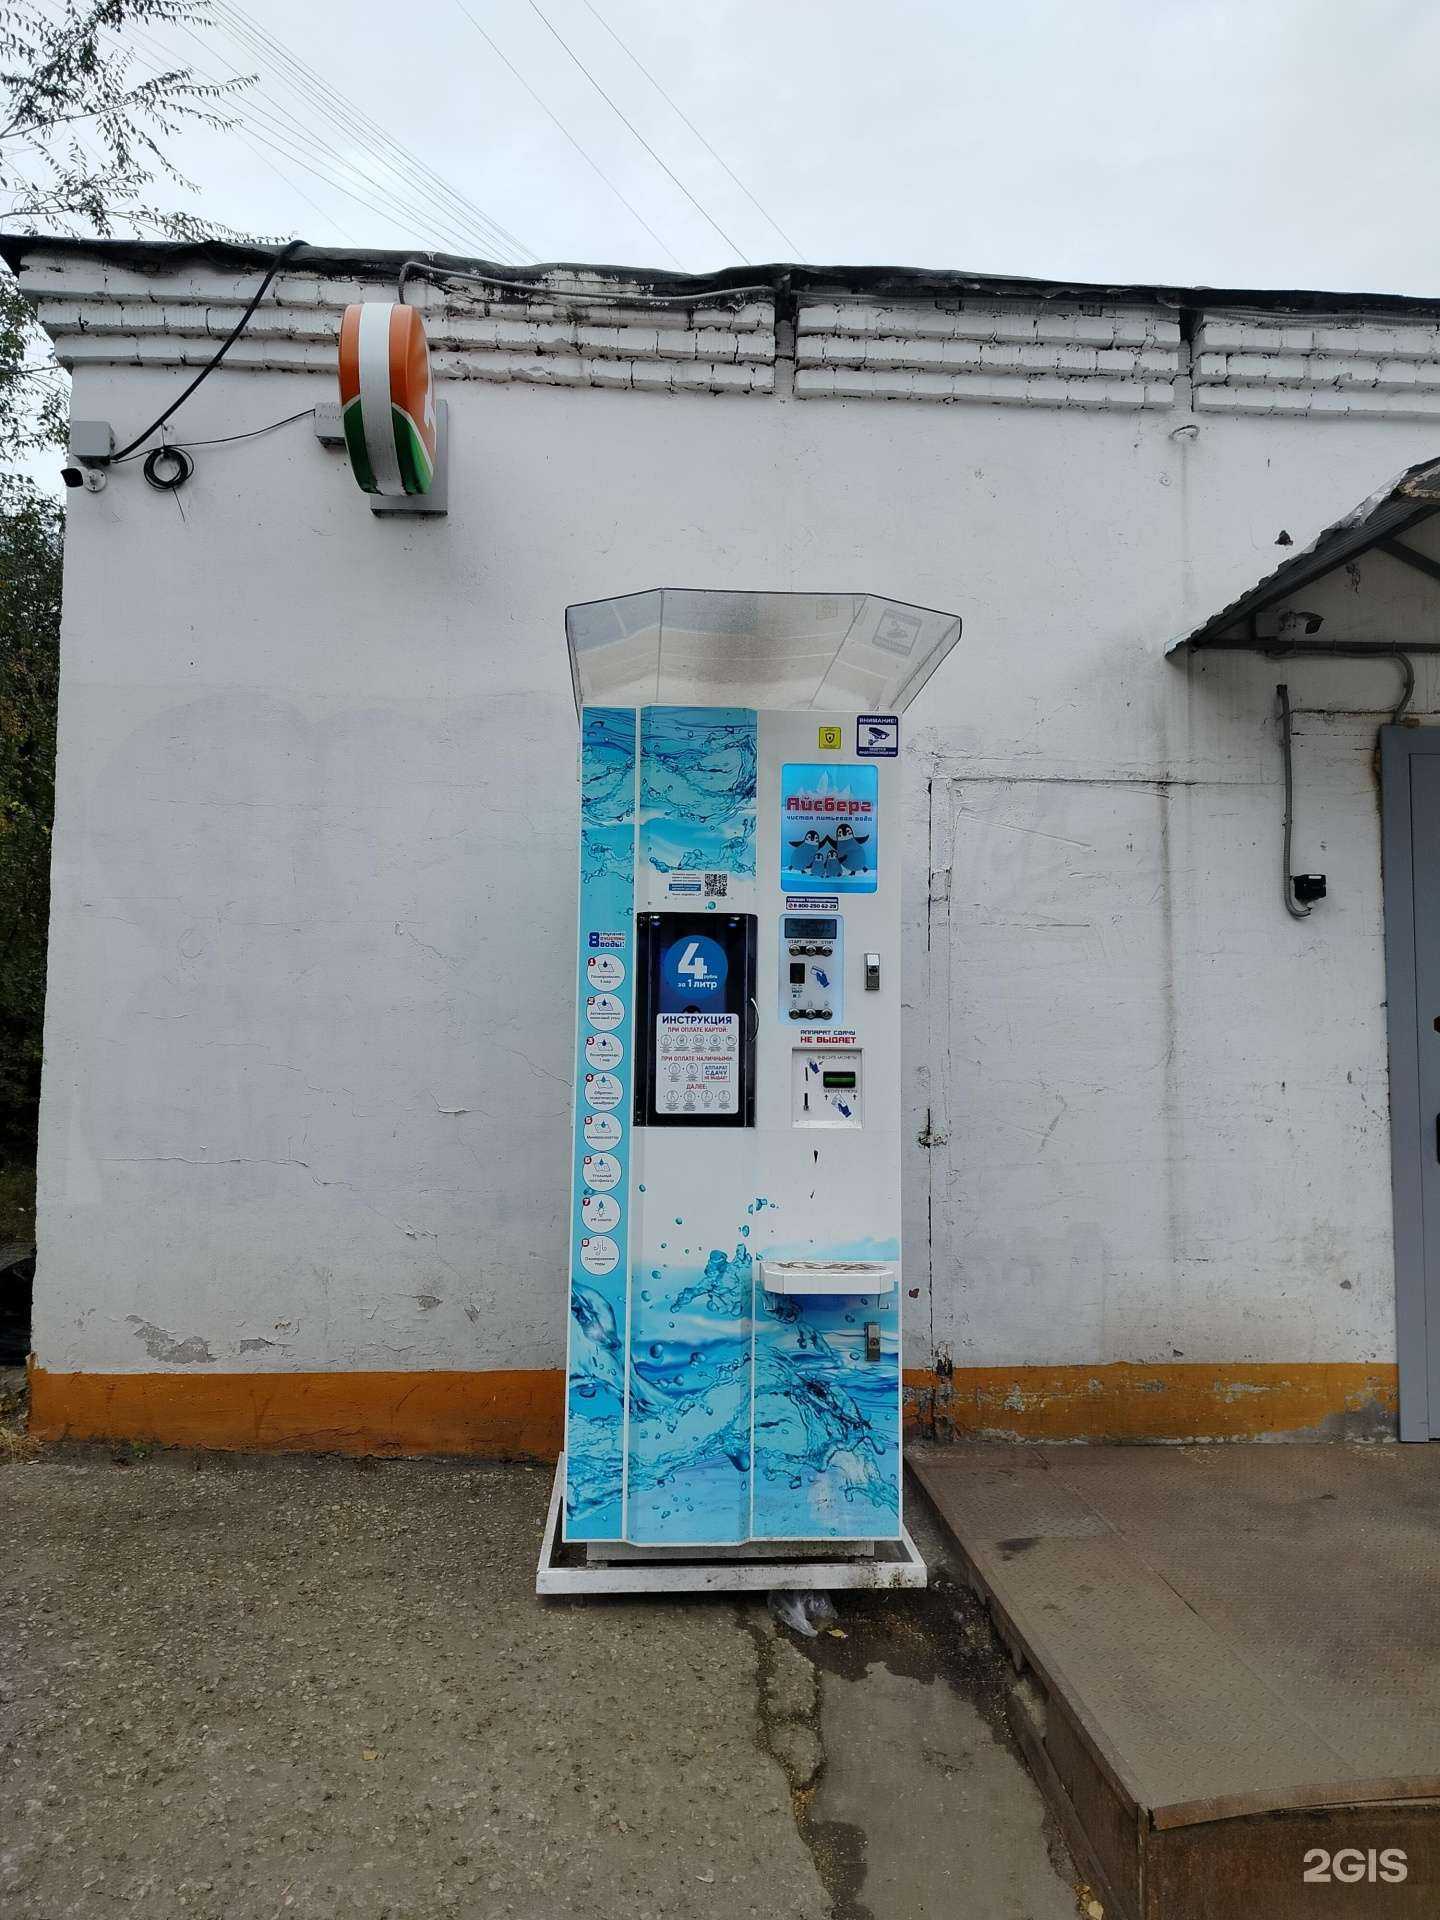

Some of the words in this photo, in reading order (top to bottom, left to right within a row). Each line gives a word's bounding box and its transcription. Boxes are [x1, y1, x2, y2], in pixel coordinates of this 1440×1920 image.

[786, 796, 872, 816] Айсберг
[588, 931, 600, 948] 8
[677, 942, 708, 980] 4
[687, 979, 692, 988] 1
[693, 980, 718, 990] литр
[662, 1015, 732, 1025] ИНСТРУКЦИЯ
[816, 1036, 857, 1044] ВЫДАЕТ
